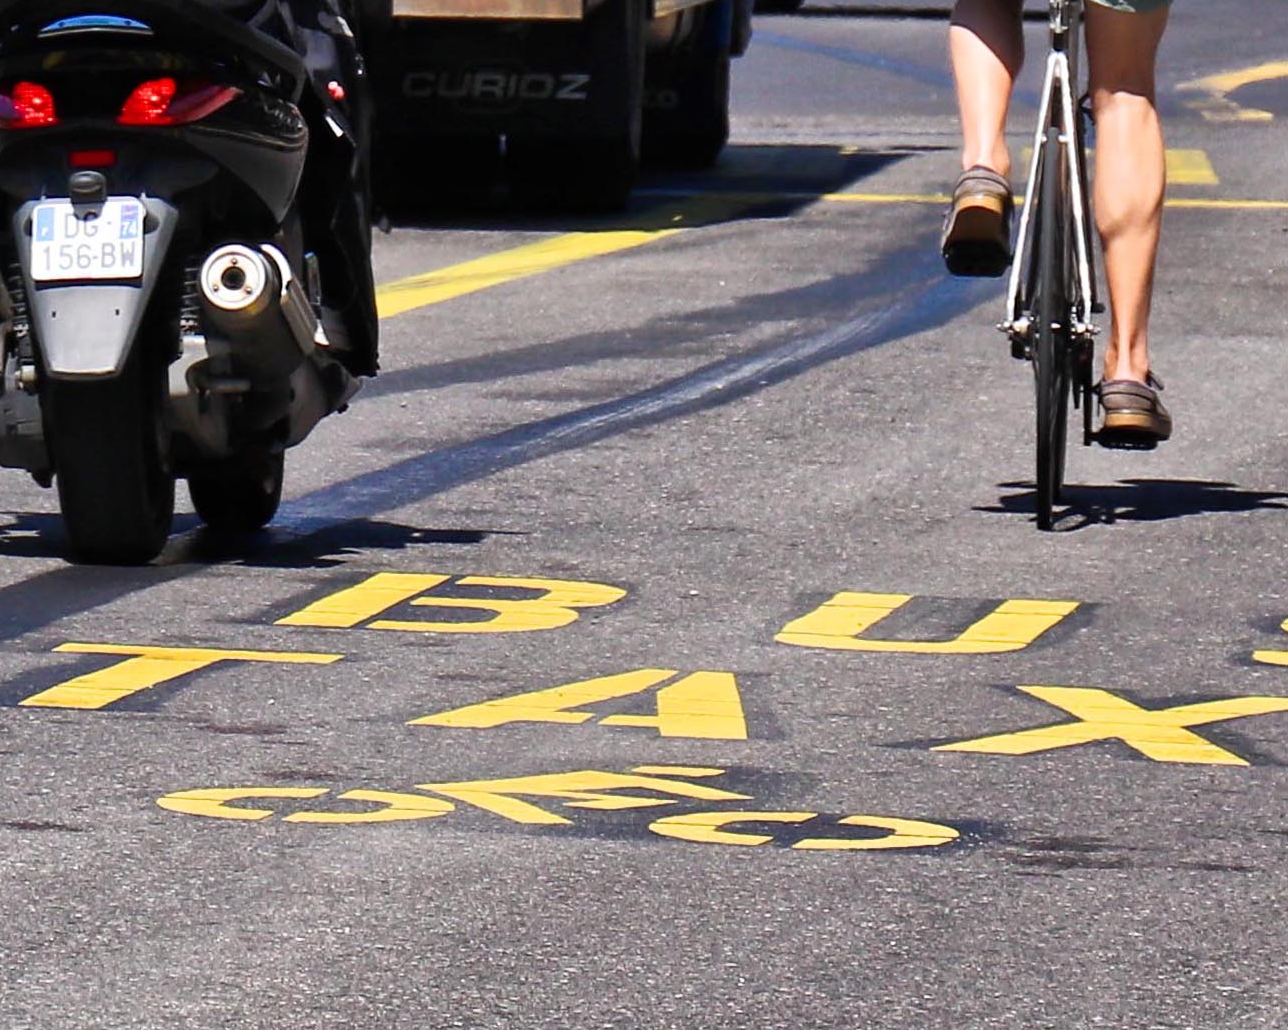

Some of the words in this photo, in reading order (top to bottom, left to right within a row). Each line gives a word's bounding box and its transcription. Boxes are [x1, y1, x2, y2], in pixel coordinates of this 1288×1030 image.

[401, 70, 592, 100] CURIOZ
[43, 241, 136, 271] 156-BW
[276, 571, 1288, 667] BU
